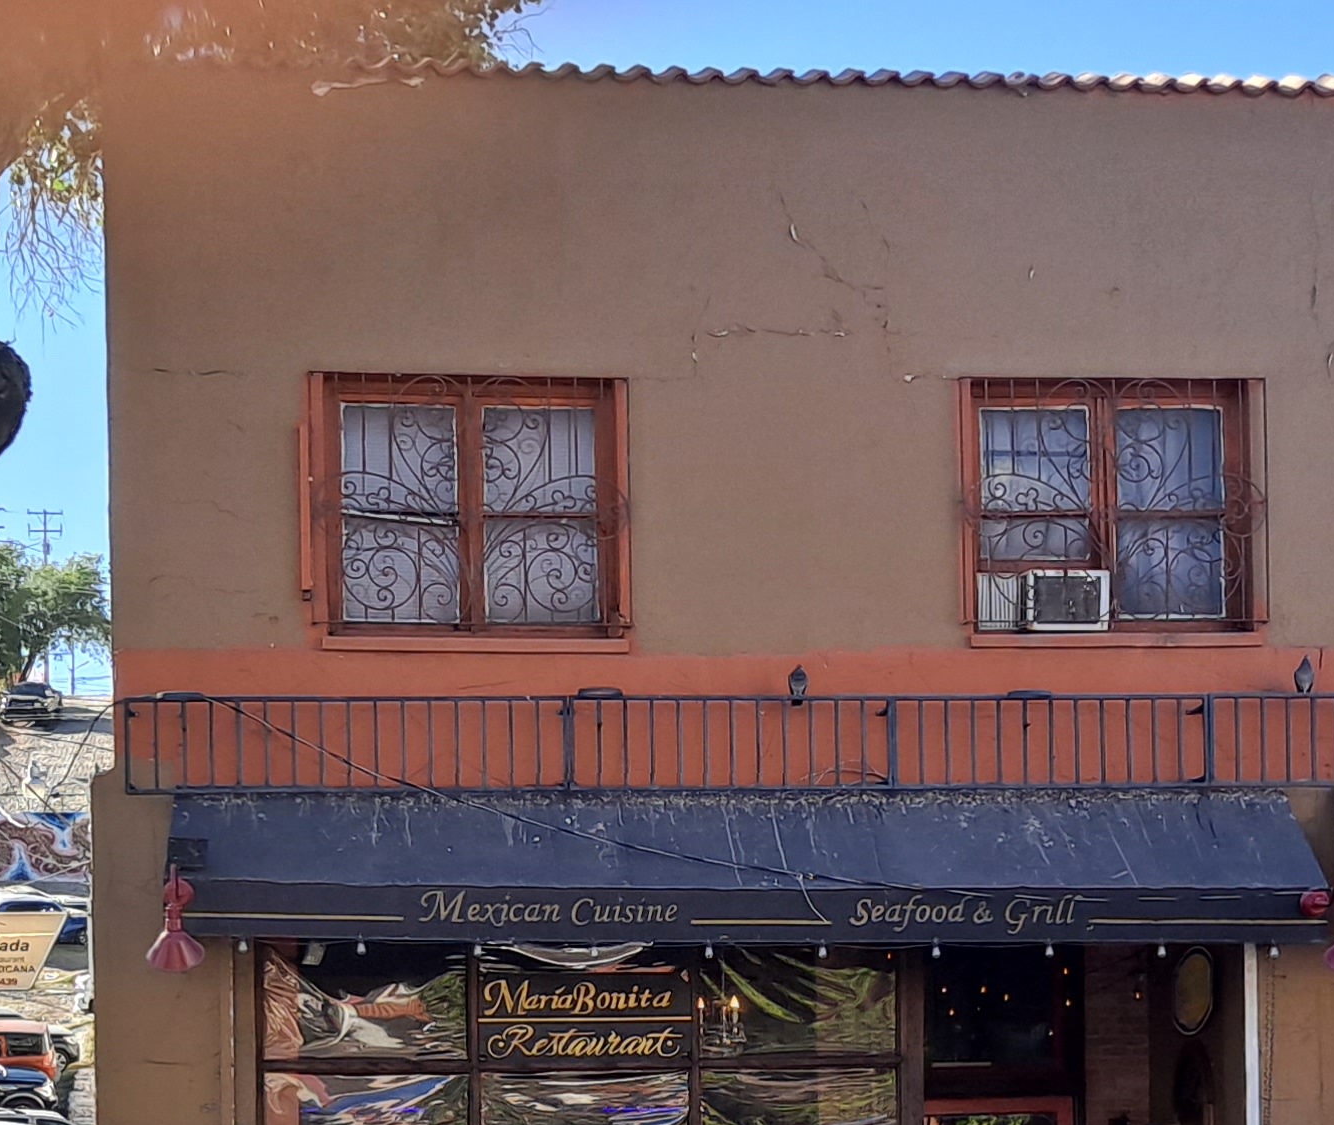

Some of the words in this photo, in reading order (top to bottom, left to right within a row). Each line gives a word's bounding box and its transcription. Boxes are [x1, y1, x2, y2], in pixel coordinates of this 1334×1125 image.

[419, 889, 560, 927] Mexican
[571, 897, 678, 926] Cuisine
[849, 894, 974, 932] Seafood
[972, 901, 994, 924] &
[1004, 895, 1079, 934] Grill
[487, 1023, 683, 1058] Restaurant
